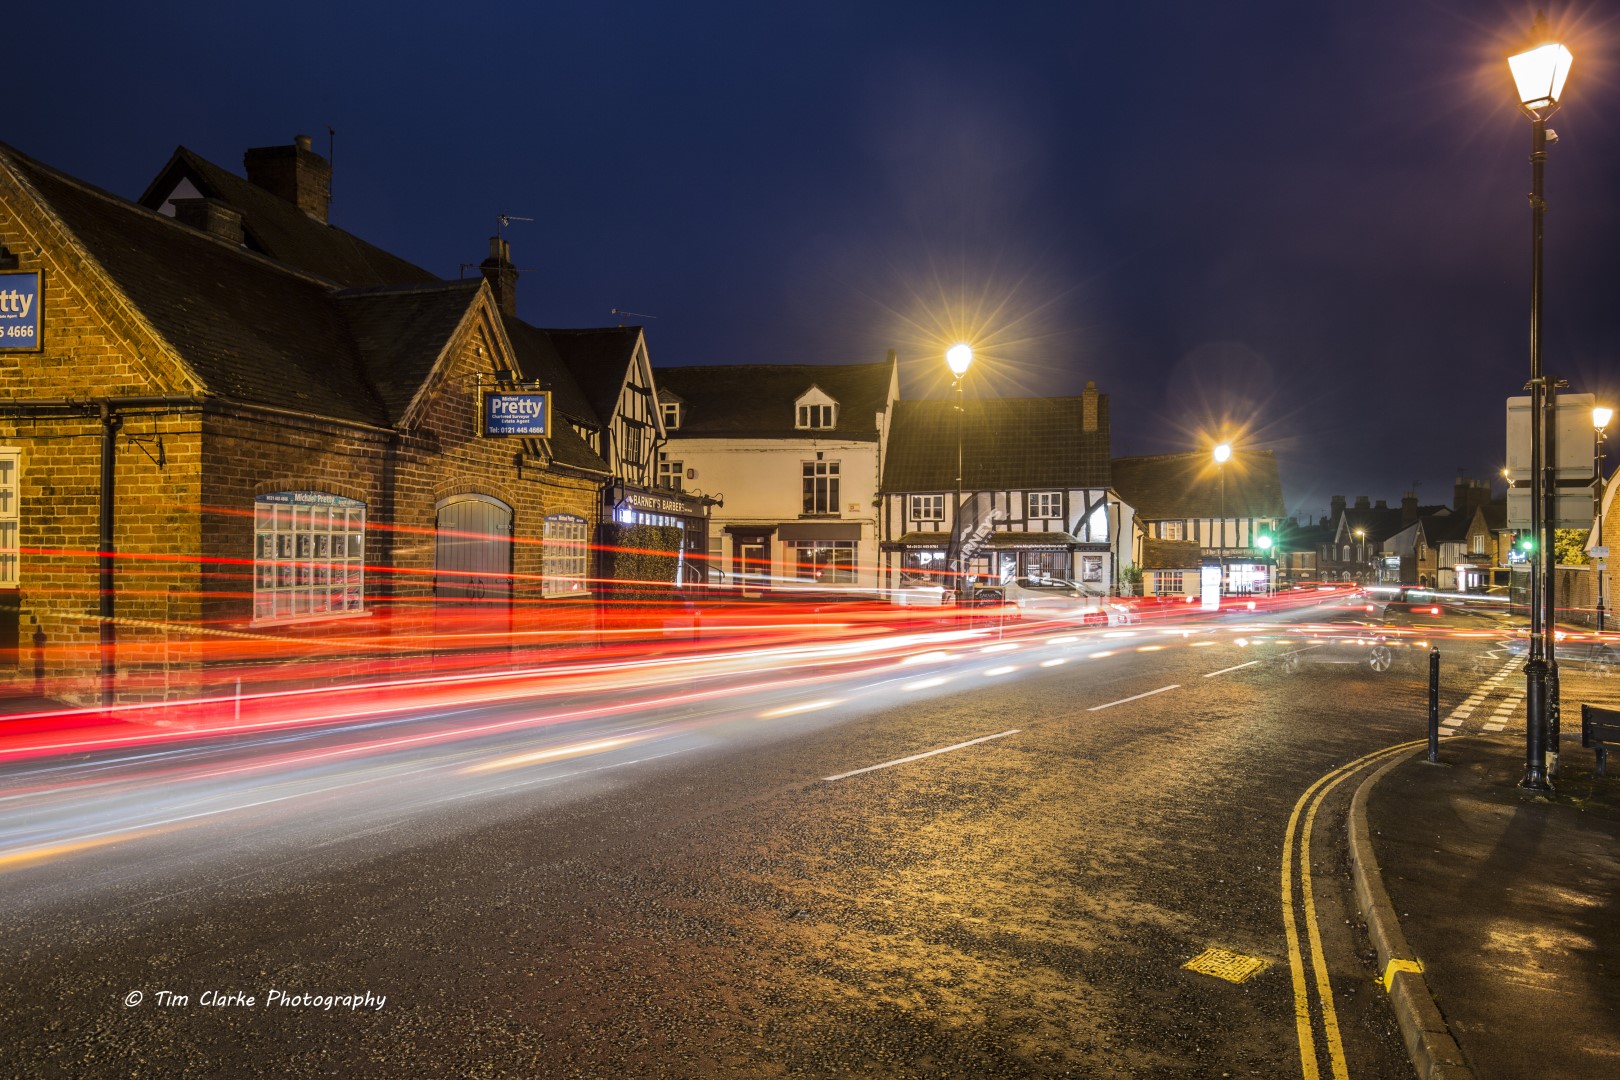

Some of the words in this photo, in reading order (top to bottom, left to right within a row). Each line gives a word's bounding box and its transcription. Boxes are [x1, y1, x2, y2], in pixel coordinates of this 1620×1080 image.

[7, 325, 34, 338] 4666
[492, 398, 542, 418] Pretty
[489, 426, 500, 434] Tel:
[500, 426, 515, 434] 0121
[516, 426, 528, 434] 445
[529, 426, 544, 434] 4666
[317, 494, 335, 505] Pretty
[633, 494, 661, 509] BARNEY'S
[662, 499, 685, 512] BARBERS
